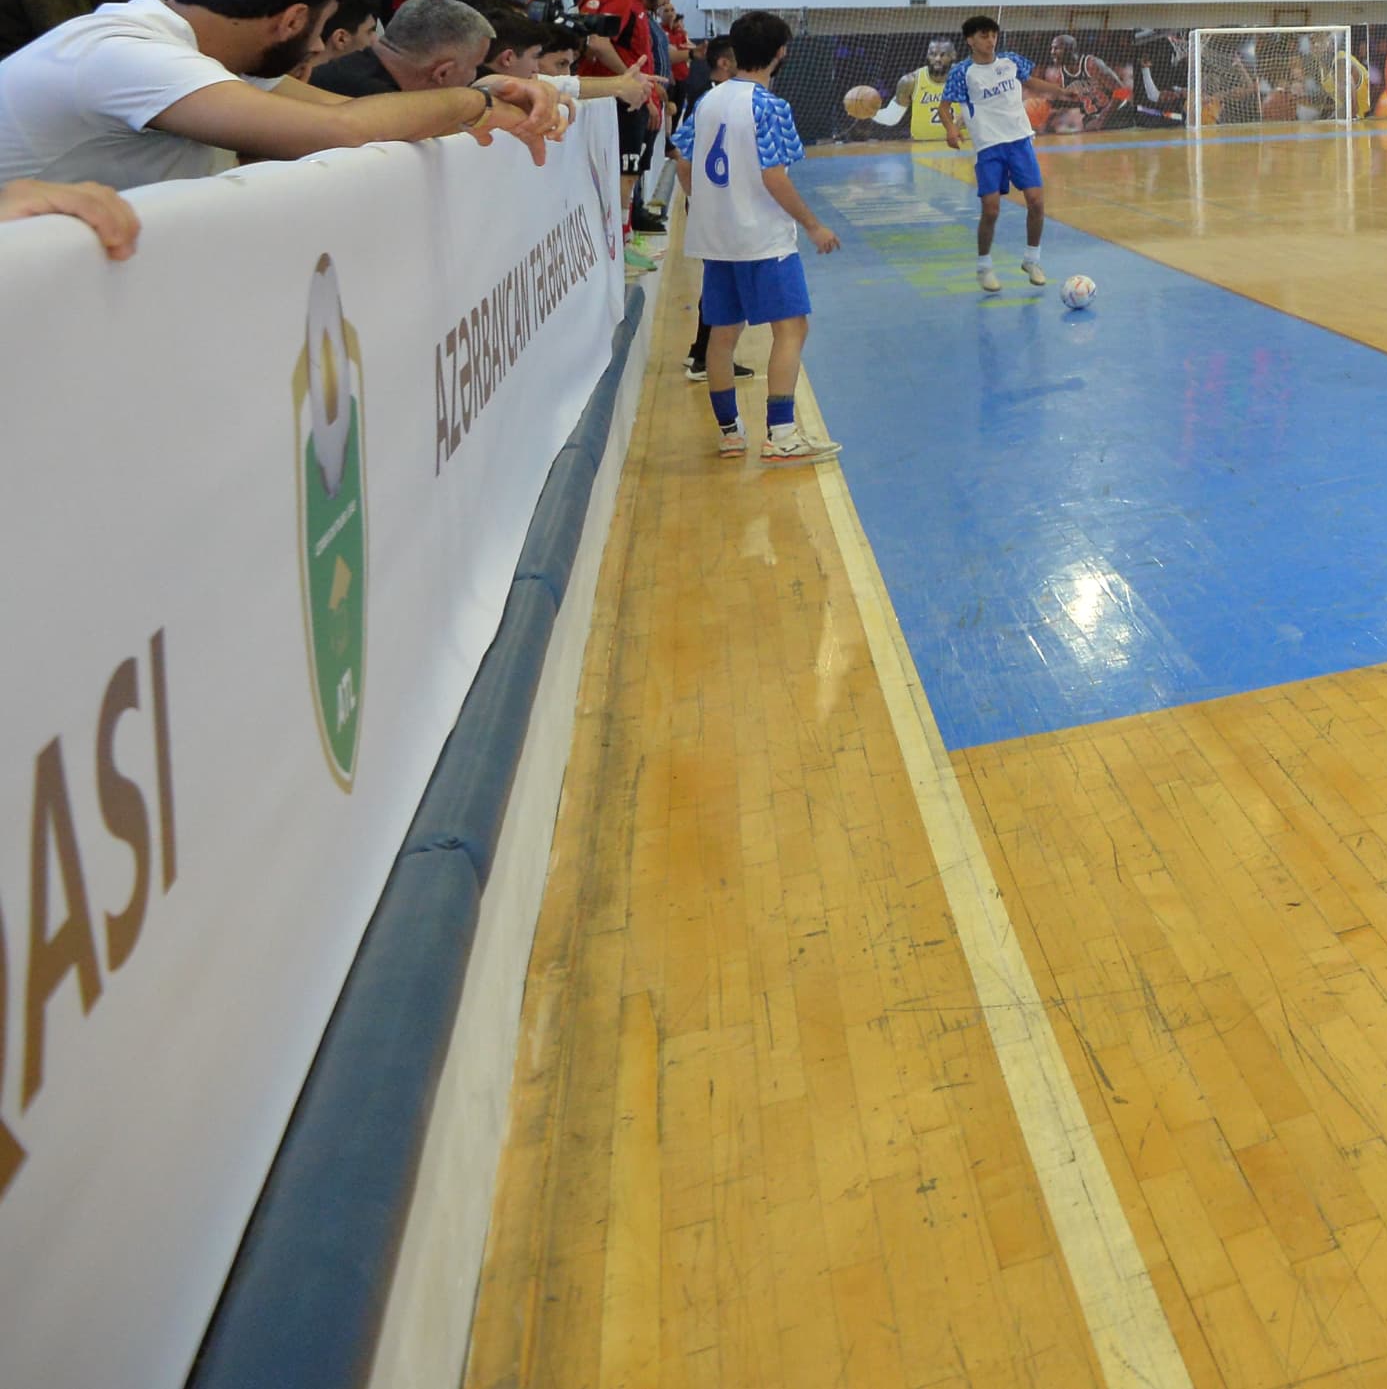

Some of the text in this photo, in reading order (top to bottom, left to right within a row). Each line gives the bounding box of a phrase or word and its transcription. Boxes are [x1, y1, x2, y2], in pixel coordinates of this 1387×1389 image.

[983, 78, 1016, 99] AzTU
[622, 153, 641, 171] 17
[705, 123, 730, 189] 6
[435, 198, 597, 476] AZƏRBAYCAN TƏLƏBƏ LİQASI
[326, 666, 356, 734] ATL
[0, 625, 178, 1204] ASI
